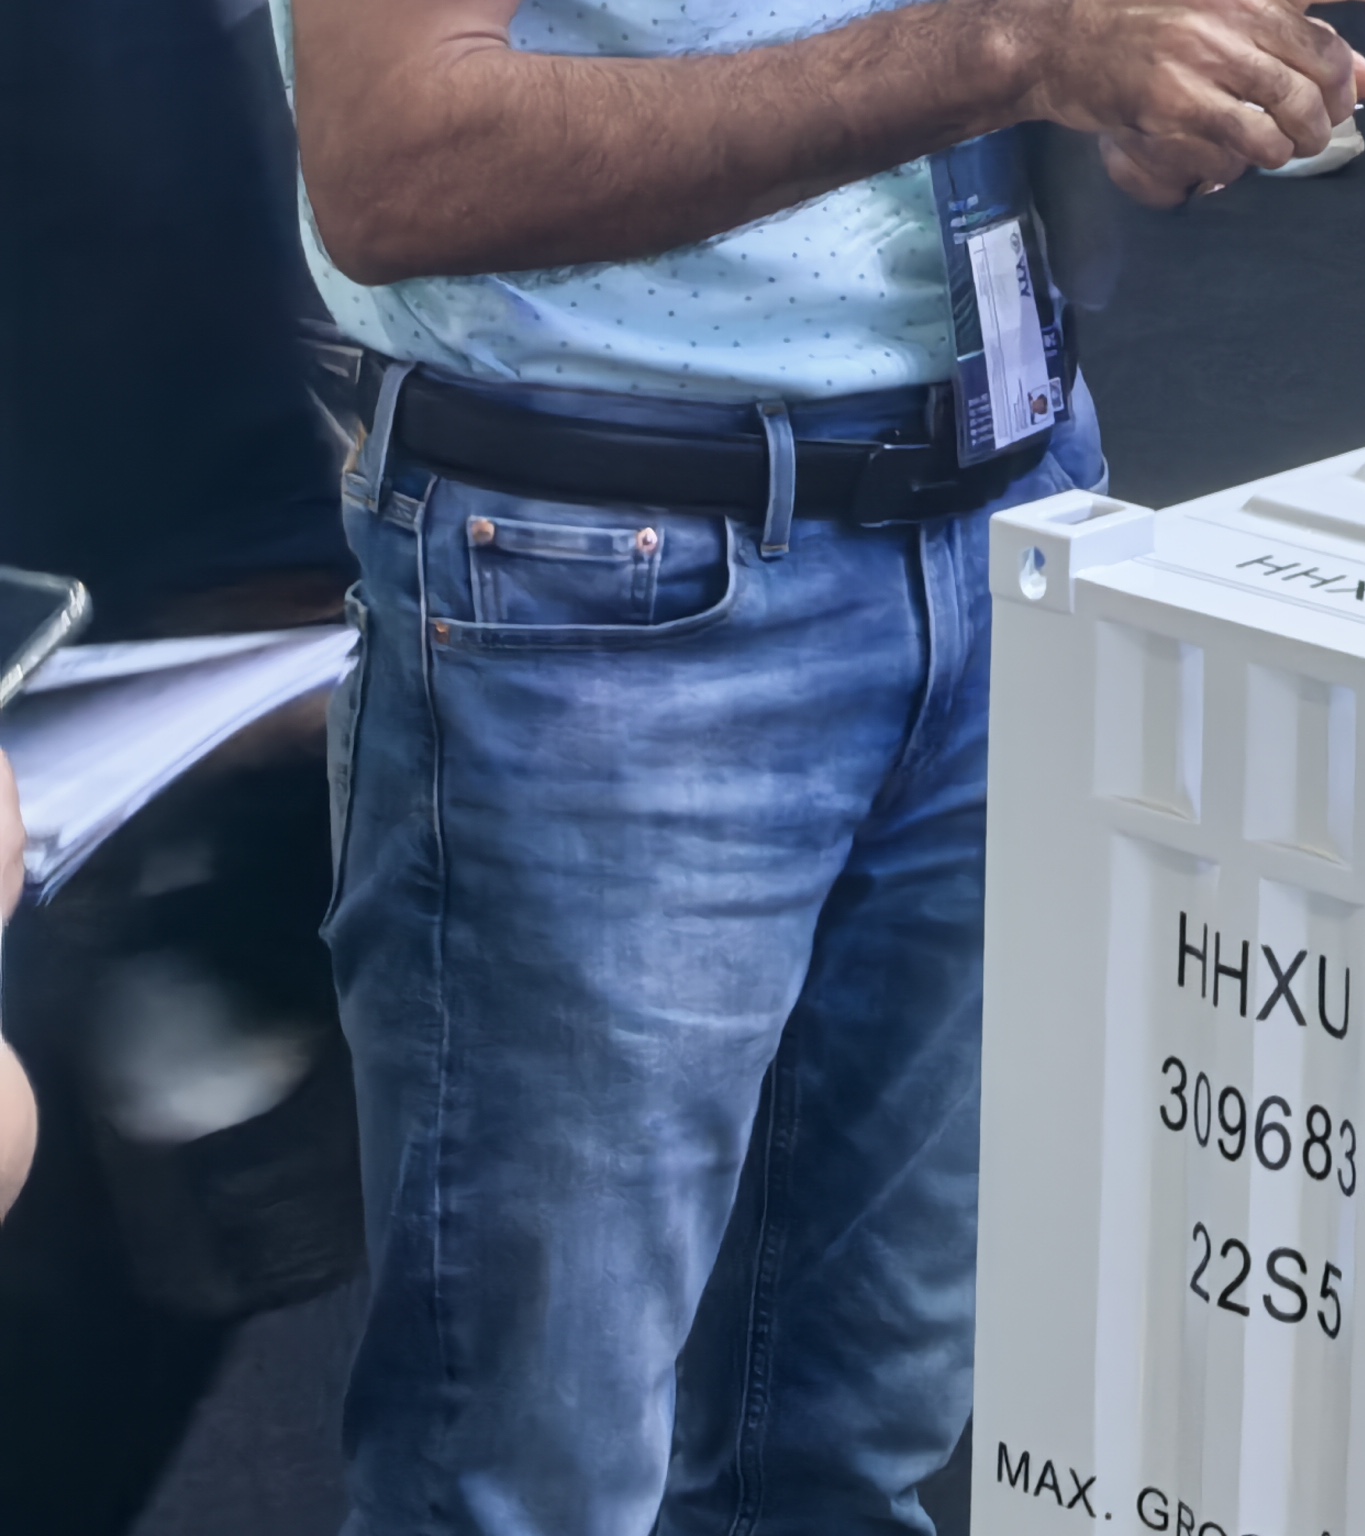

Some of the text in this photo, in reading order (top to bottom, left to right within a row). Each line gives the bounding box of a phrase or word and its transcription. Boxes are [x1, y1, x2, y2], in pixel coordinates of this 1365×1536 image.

[1177, 910, 1350, 1040] HHXU
[1189, 1221, 1343, 1340] 22S5
[996, 1440, 1113, 1521] MAX.
